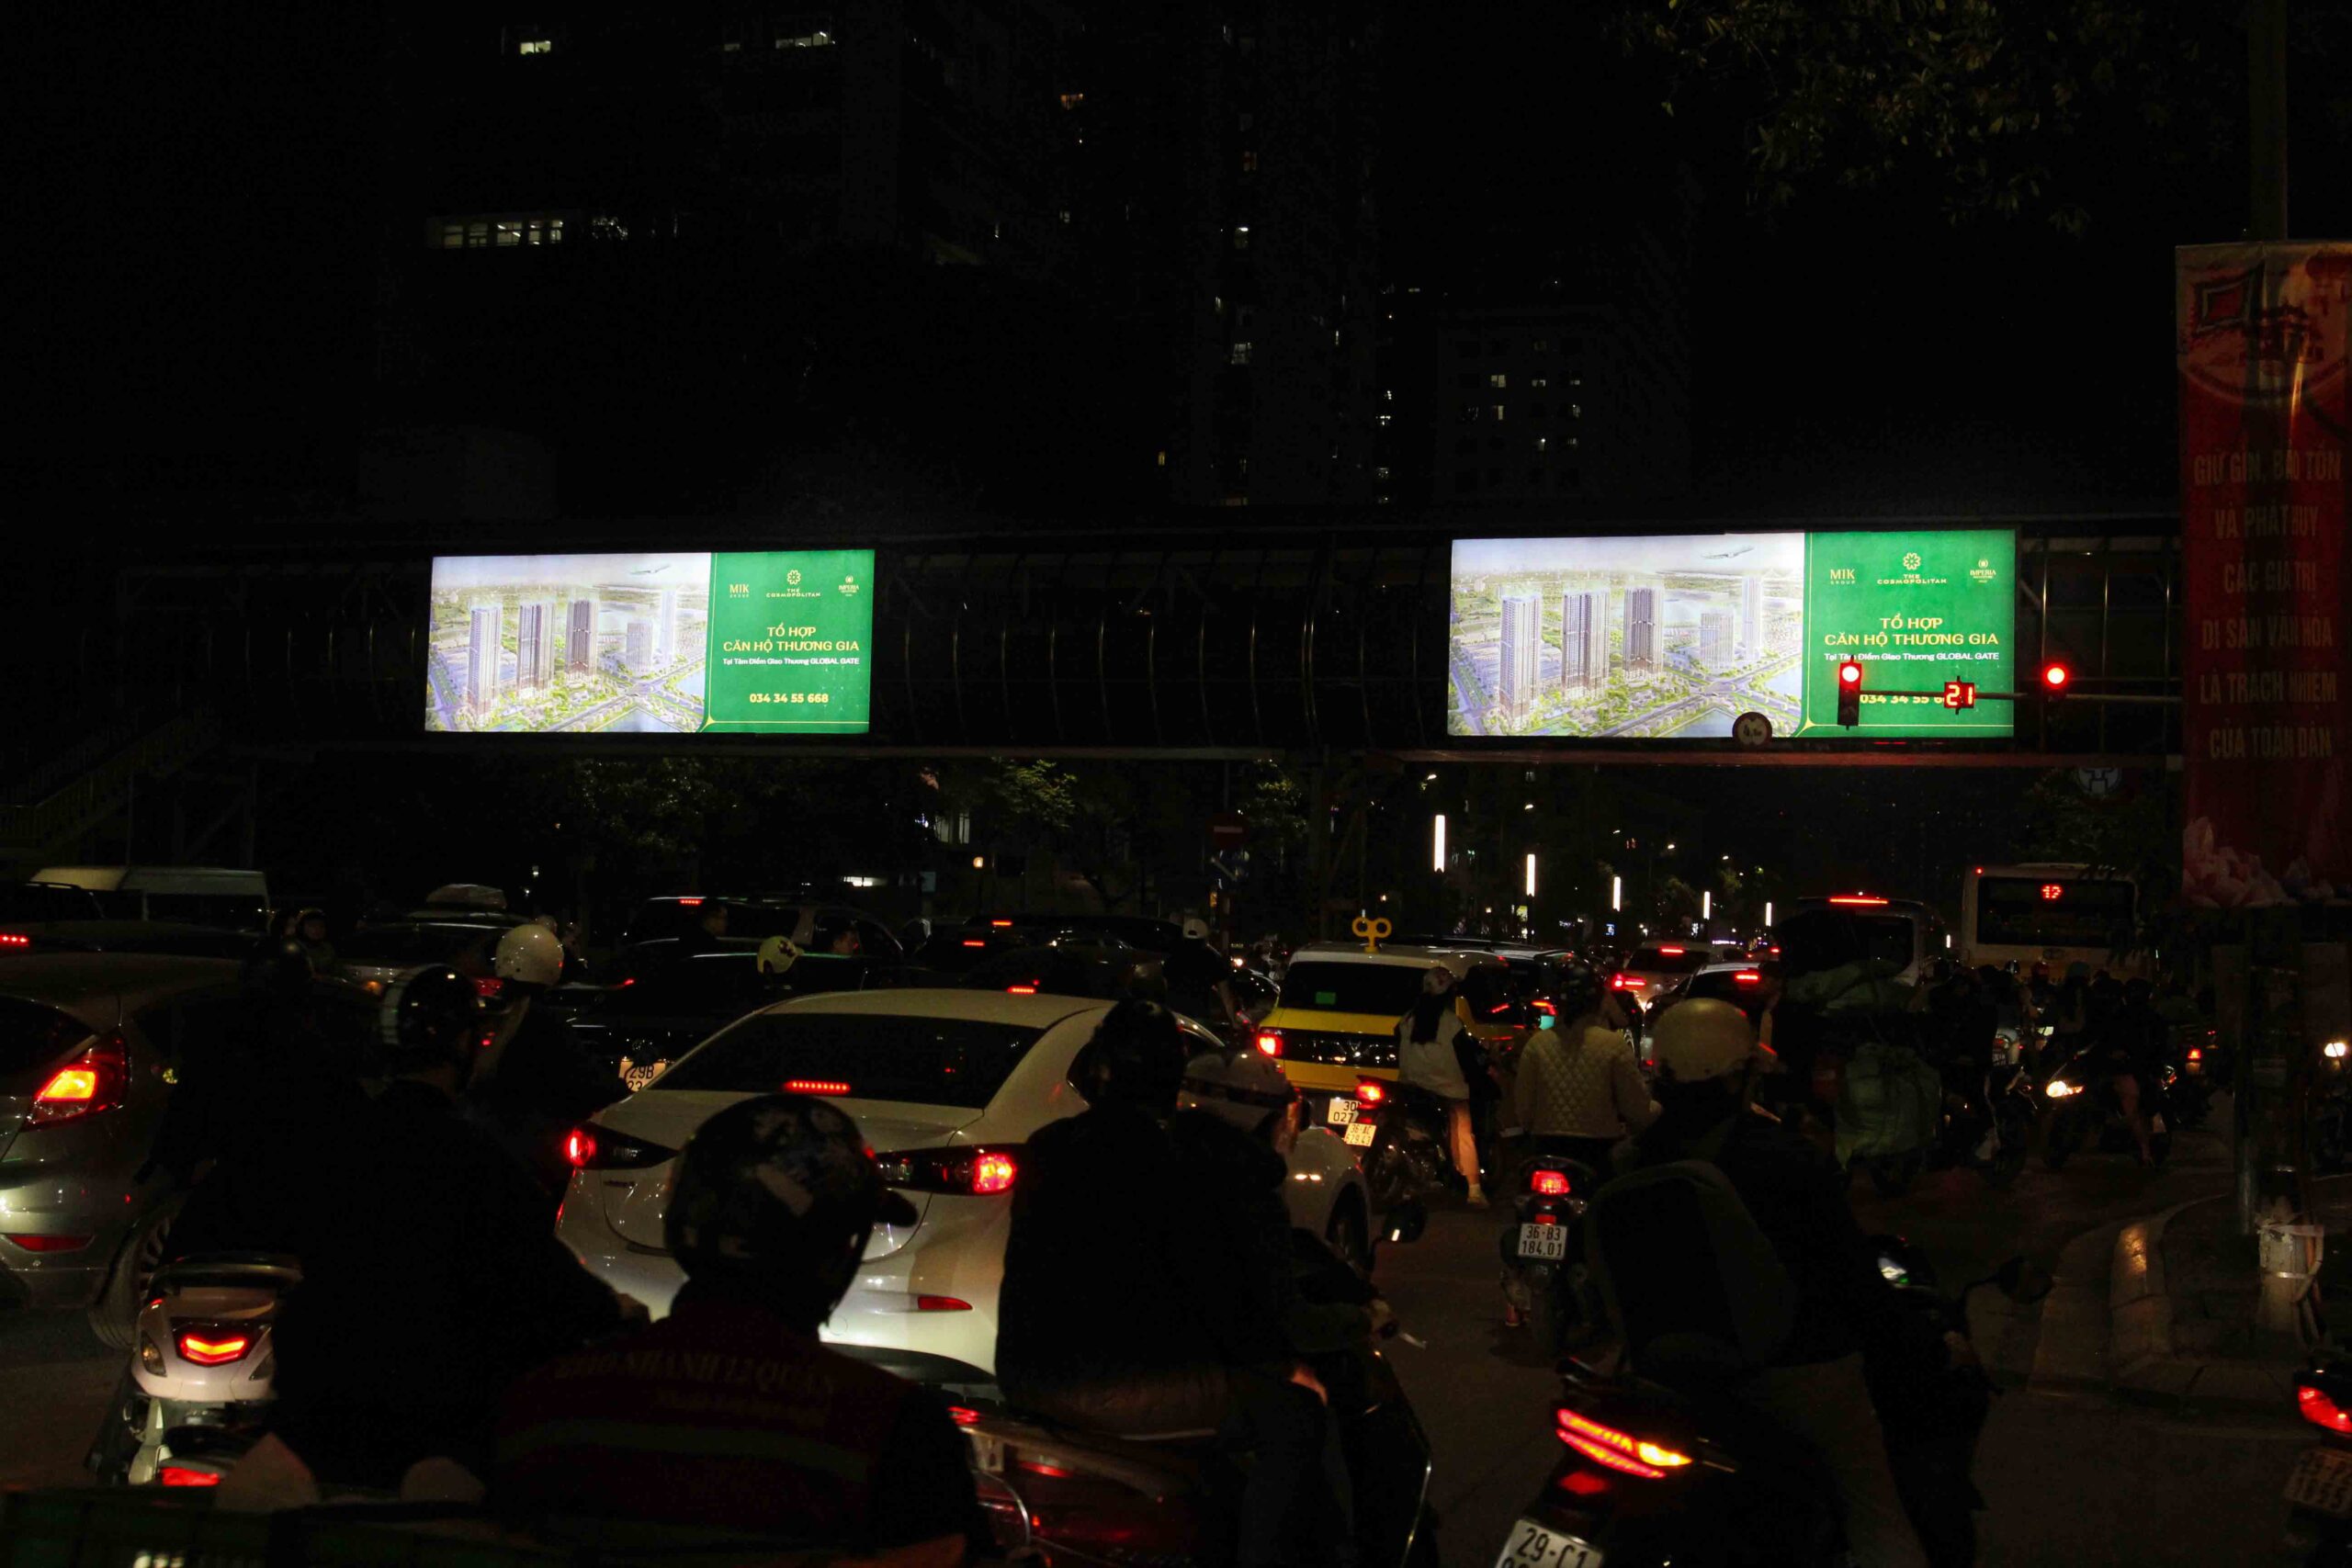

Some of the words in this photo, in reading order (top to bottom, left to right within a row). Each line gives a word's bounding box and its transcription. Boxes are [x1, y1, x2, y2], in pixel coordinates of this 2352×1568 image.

[1830, 569, 1855, 580] MIK
[729, 584, 750, 593] MIK
[1880, 614, 1904, 629] TỔ
[1907, 618, 1943, 631] HỢP
[788, 626, 817, 638] HỢP
[723, 639, 751, 651] CĂN
[753, 639, 774, 653] HỘ
[776, 640, 832, 651] THƯƠNG
[835, 640, 860, 651] GIA
[1824, 632, 1860, 645] CĂN
[1863, 632, 1888, 647] HỘ
[1893, 634, 1964, 645] THƯƠNG
[1969, 633, 1999, 644] GIA
[1936, 652, 1973, 660] GLOBAL
[750, 694, 771, 703] 034
[774, 694, 787, 703] 34
[791, 694, 804, 703] 55
[808, 694, 829, 703] 668
[1946, 684, 1973, 705] 21
[1522, 1241, 1562, 1257] 184.01
